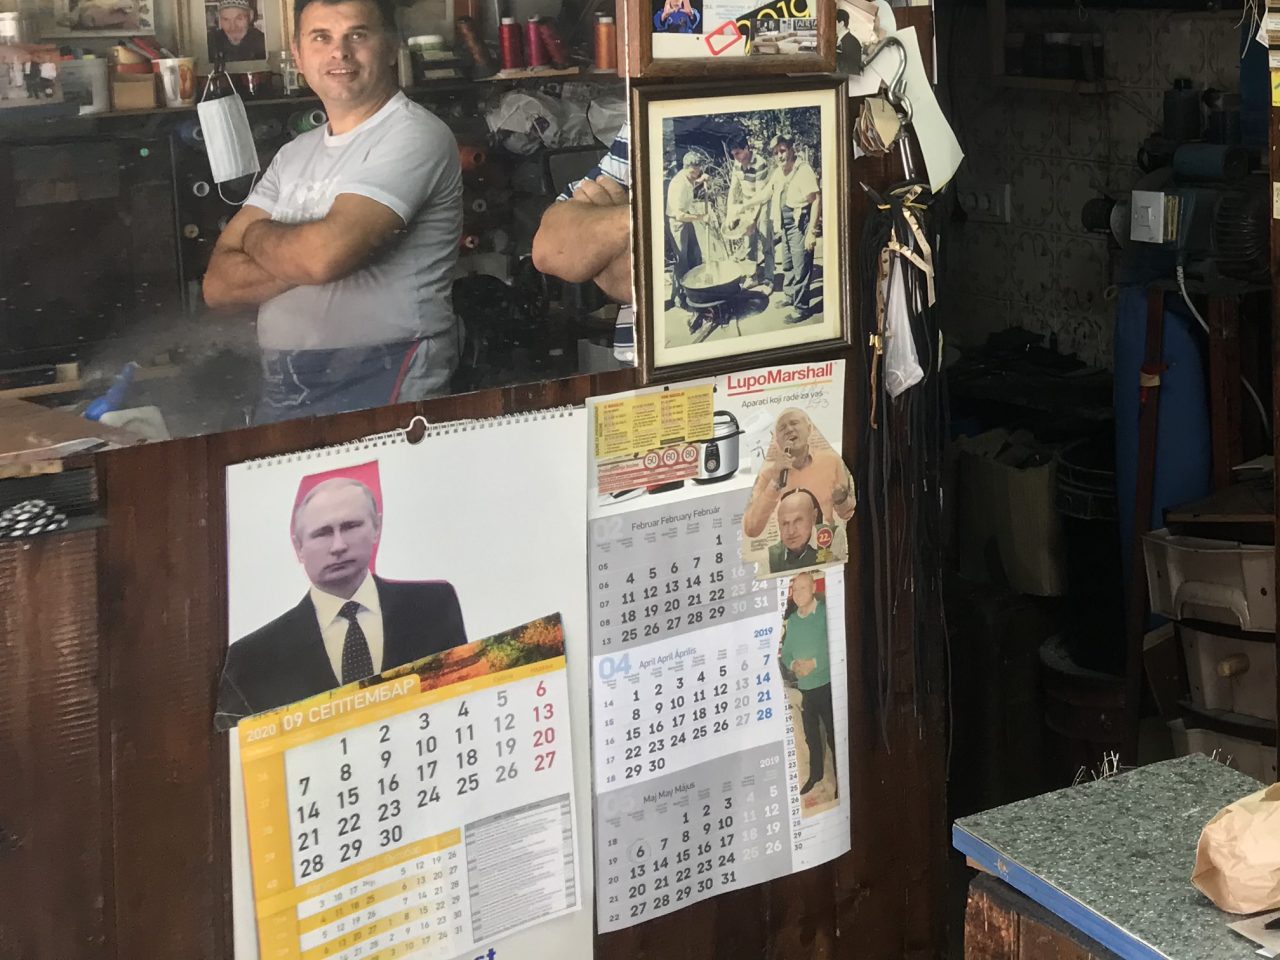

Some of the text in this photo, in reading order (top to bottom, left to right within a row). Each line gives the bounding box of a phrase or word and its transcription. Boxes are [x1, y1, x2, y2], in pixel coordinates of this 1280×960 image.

[727, 363, 832, 391] LupoMarshall
[742, 397, 768, 409] Aparati
[783, 393, 799, 401] rade
[632, 506, 720, 531] Februar February Február
[598, 535, 722, 571] 05 1
[626, 573, 634, 584] 4
[650, 568, 656, 579] 5
[671, 562, 678, 574] 6
[693, 557, 700, 568] 7
[716, 552, 723, 563] 8
[622, 571, 724, 604] 11 12 13 14 15
[599, 627, 773, 679] 04 April April Április 2019
[632, 672, 770, 720] 8 9 10 11 12 13 14
[634, 654, 770, 701] 1 2 3 4 5 6 7
[246, 678, 415, 744] 2020 09 СЕПТЕМБАР
[341, 681, 546, 755] 1 2 3 4 5 6
[626, 708, 772, 760] 22 23 24 25 26 27 28
[627, 690, 771, 741] 15 16 17 18 19 20 21
[300, 703, 553, 796] 7 8 9 10 11 12 13
[626, 758, 665, 779] 29 30
[760, 756, 779, 768] 2019
[298, 727, 555, 823] 14 15 16 17 18 19 20
[643, 782, 695, 805] Maj May Május
[298, 751, 555, 851] 21 22 23 24 25 26 27
[683, 785, 778, 824] 1 2 3 5
[301, 825, 402, 878] 28 29 30
[637, 804, 779, 857] 6 7 8 9 10 12
